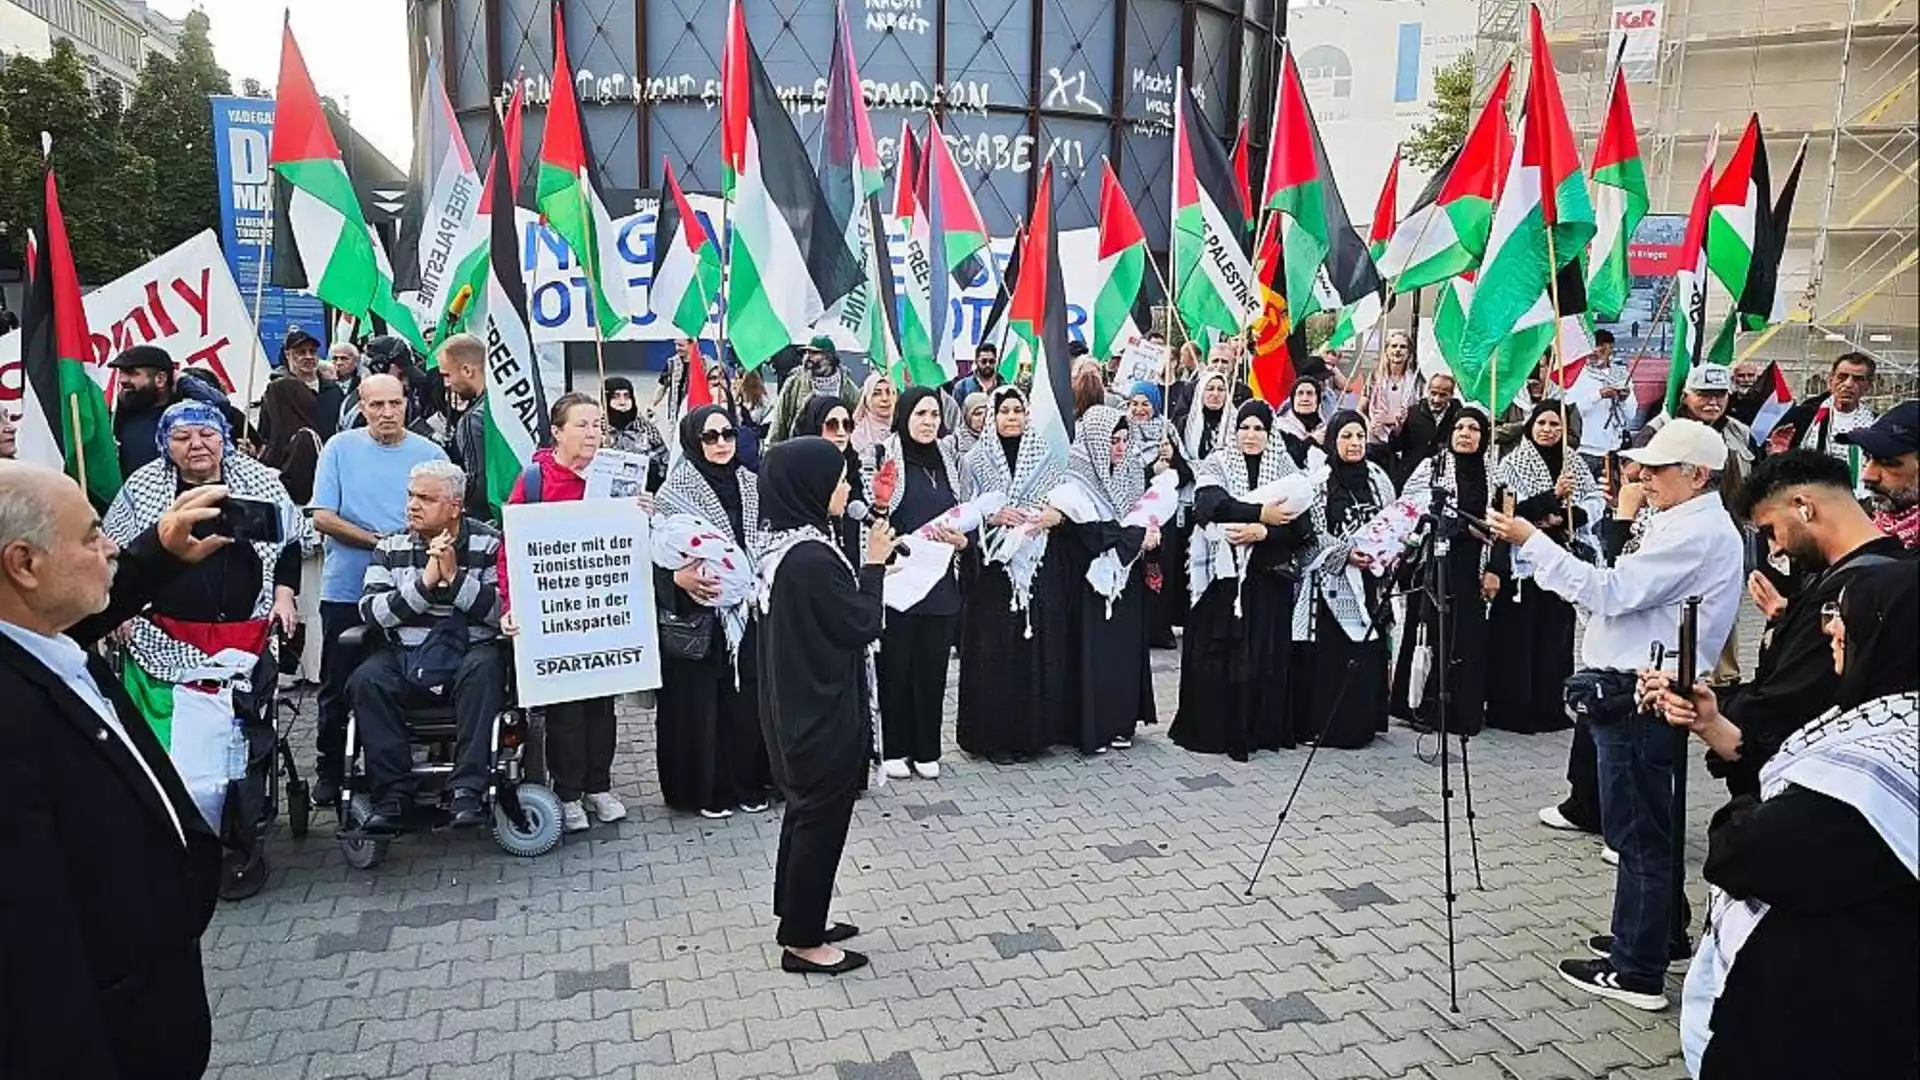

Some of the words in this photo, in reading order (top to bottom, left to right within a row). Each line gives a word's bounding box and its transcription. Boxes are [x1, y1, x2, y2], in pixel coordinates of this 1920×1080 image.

[1615, 10, 1656, 30] K&R
[908, 240, 930, 285] FREE
[1204, 234, 1261, 315] PALESTINE
[527, 540, 577, 557] Nieder
[582, 537, 605, 552] mit
[610, 536, 633, 549] der
[532, 554, 631, 574] zionistischen
[537, 575, 581, 592] Hetze
[585, 572, 630, 590] gegen
[541, 597, 582, 615] Linke
[586, 594, 601, 609] in
[604, 592, 630, 609] der
[542, 614, 631, 635] Linkspartei!
[535, 648, 643, 676] SPARTAKIST
